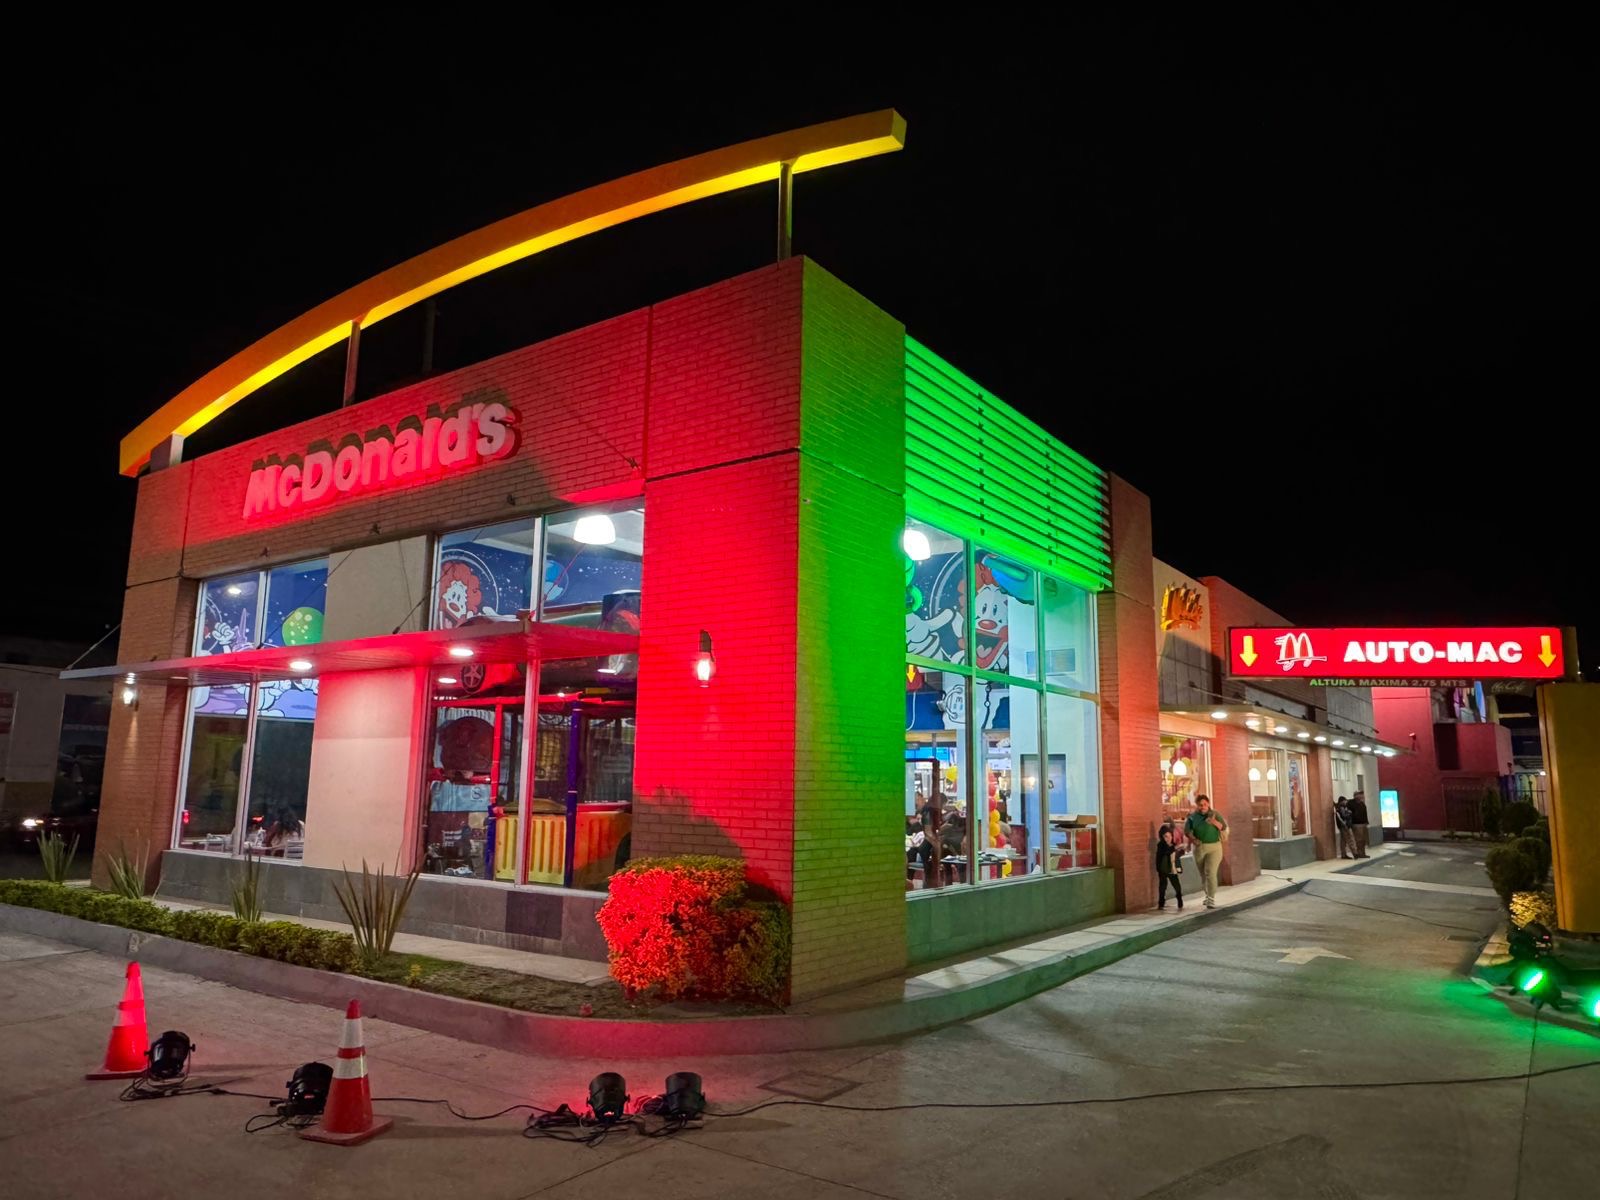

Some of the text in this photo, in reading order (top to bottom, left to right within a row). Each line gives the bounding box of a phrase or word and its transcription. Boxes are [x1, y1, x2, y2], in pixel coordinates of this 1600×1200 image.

[242, 402, 513, 520] McDonald's
[1343, 641, 1522, 664] AUTO-MAC
[1309, 678, 1467, 687] ALTURA MAXIMA 2.75 MTS
